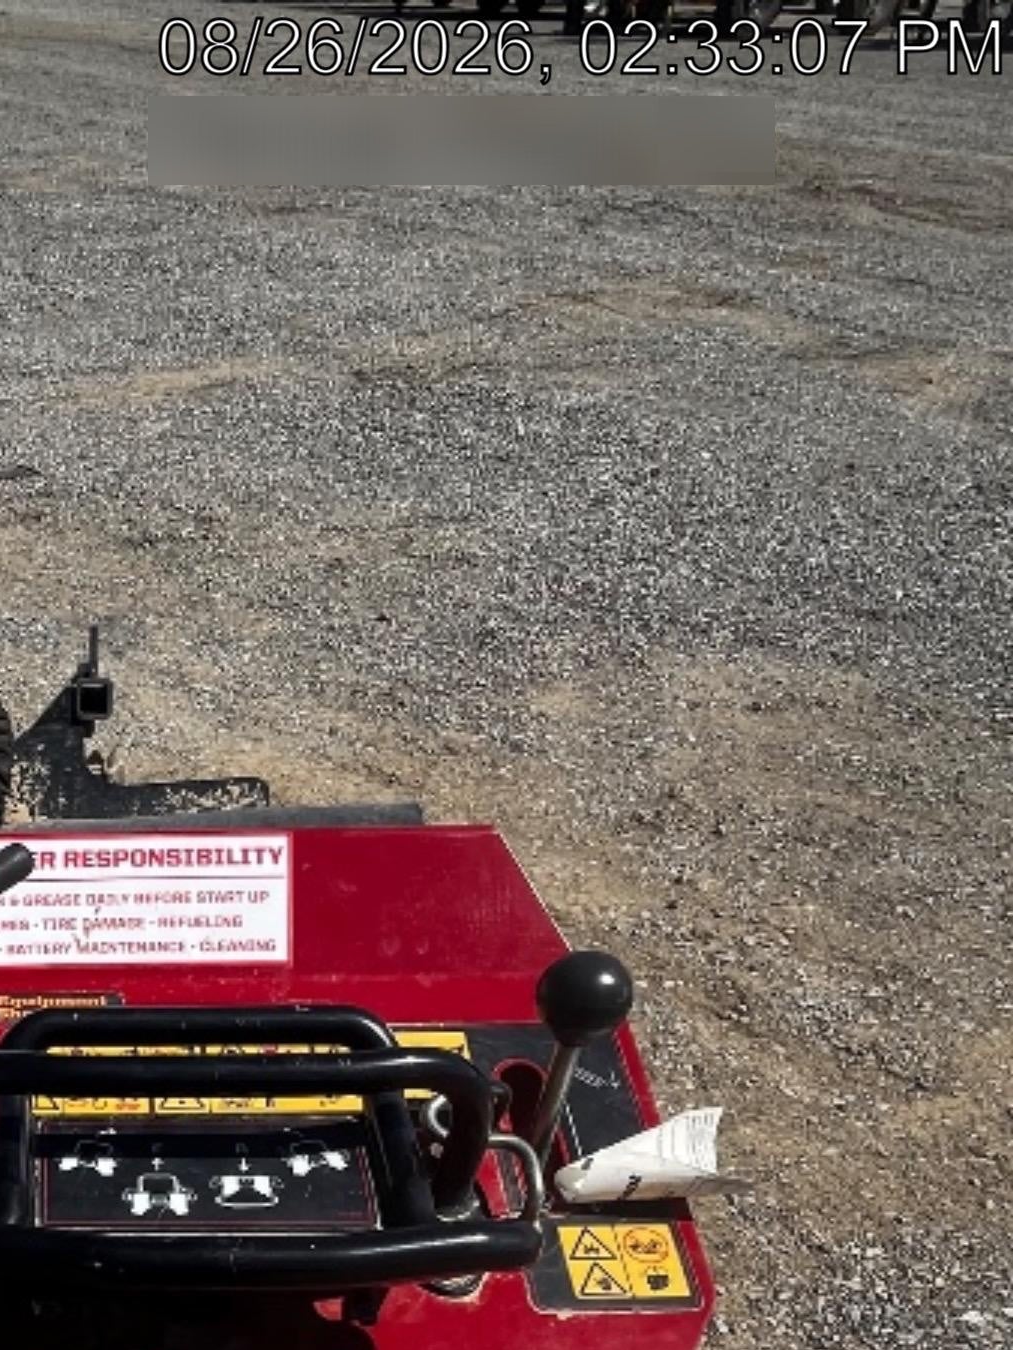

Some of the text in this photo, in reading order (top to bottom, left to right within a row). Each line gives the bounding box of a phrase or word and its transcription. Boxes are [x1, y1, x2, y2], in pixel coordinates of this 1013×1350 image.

[64, 847, 282, 868] RESPONSIBILITY
[23, 894, 80, 907] GREASE
[134, 891, 192, 904] BEFORE
[196, 890, 244, 903] START
[248, 889, 270, 903] UP
[42, 917, 77, 931] TIRE
[83, 915, 146, 930] DAMAGE
[157, 914, 242, 928] REFUELING
[6, 942, 71, 955] BATTERY
[77, 939, 185, 955] MAINTENANCE
[199, 938, 276, 952] CLEANING
